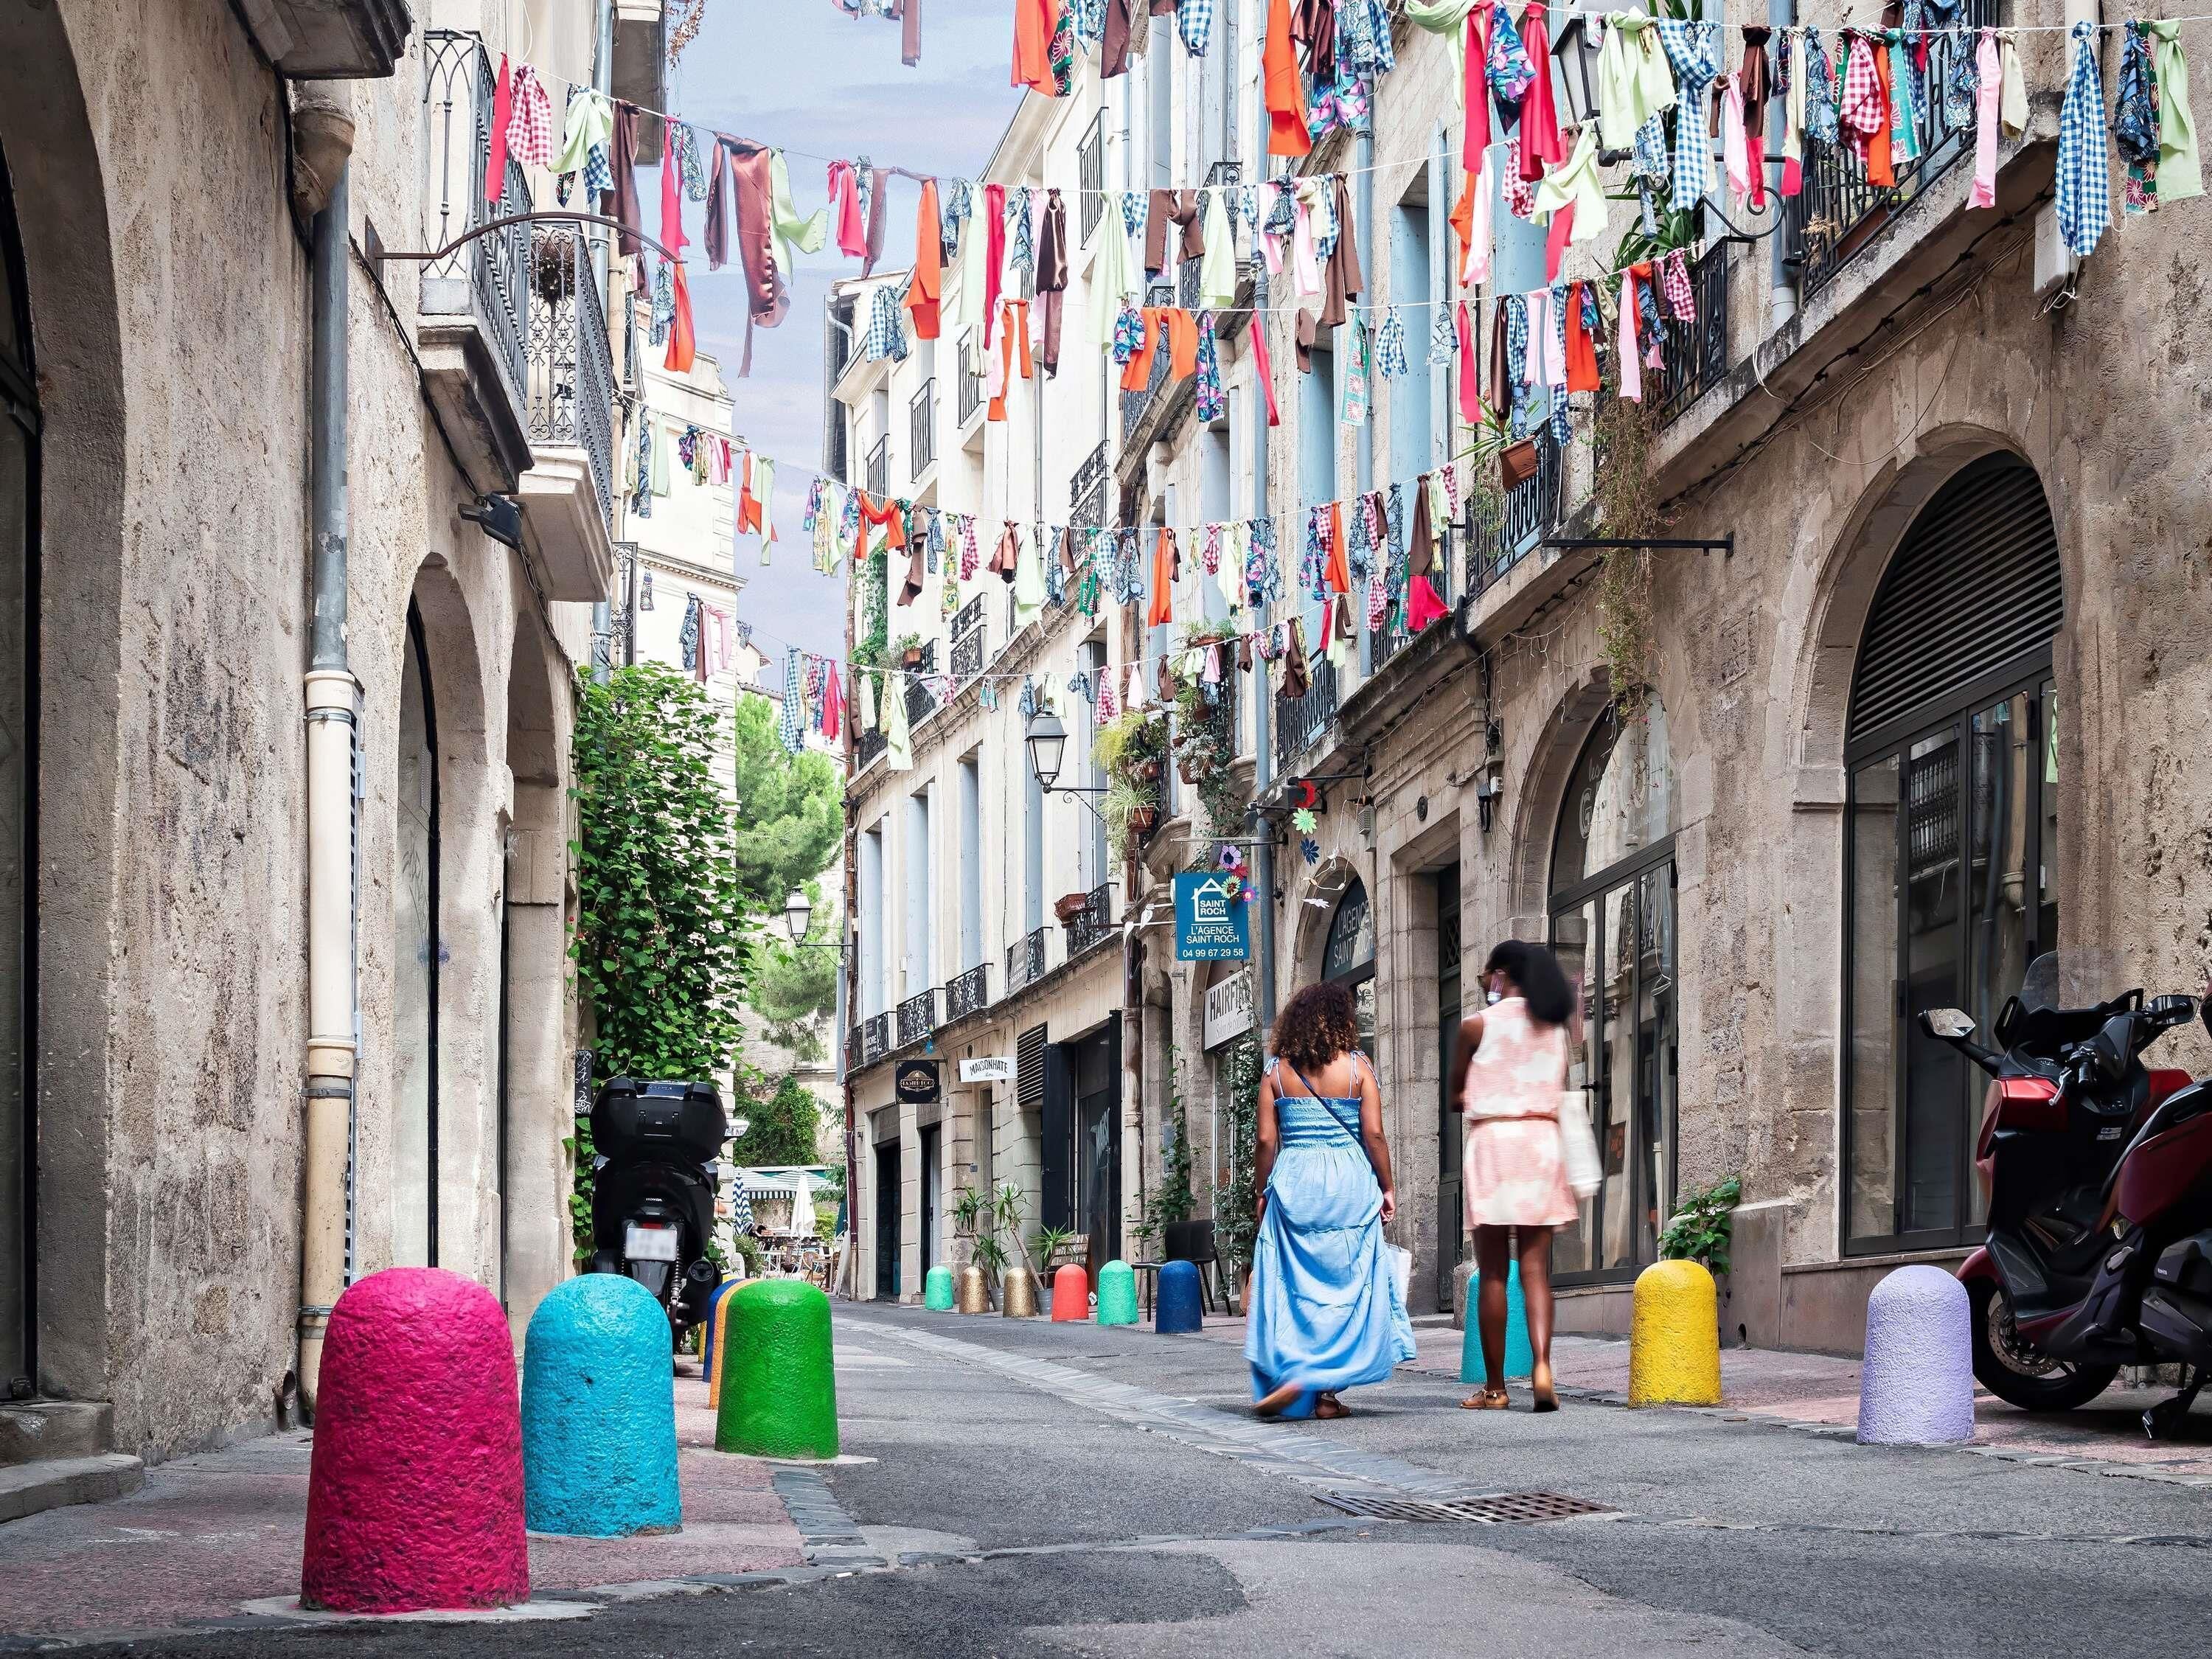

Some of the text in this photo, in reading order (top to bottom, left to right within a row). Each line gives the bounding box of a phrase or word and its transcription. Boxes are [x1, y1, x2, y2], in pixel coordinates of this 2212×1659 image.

[1200, 900, 1226, 908] SAINT
[1338, 900, 1369, 939] L'AGENCE
[1191, 925, 1234, 935] L'AGENCE
[1186, 934, 1239, 944] SAINT ROCH
[1334, 926, 1374, 967] SAINT ROCH
[1182, 947, 1244, 958] 04 99 67 29 58
